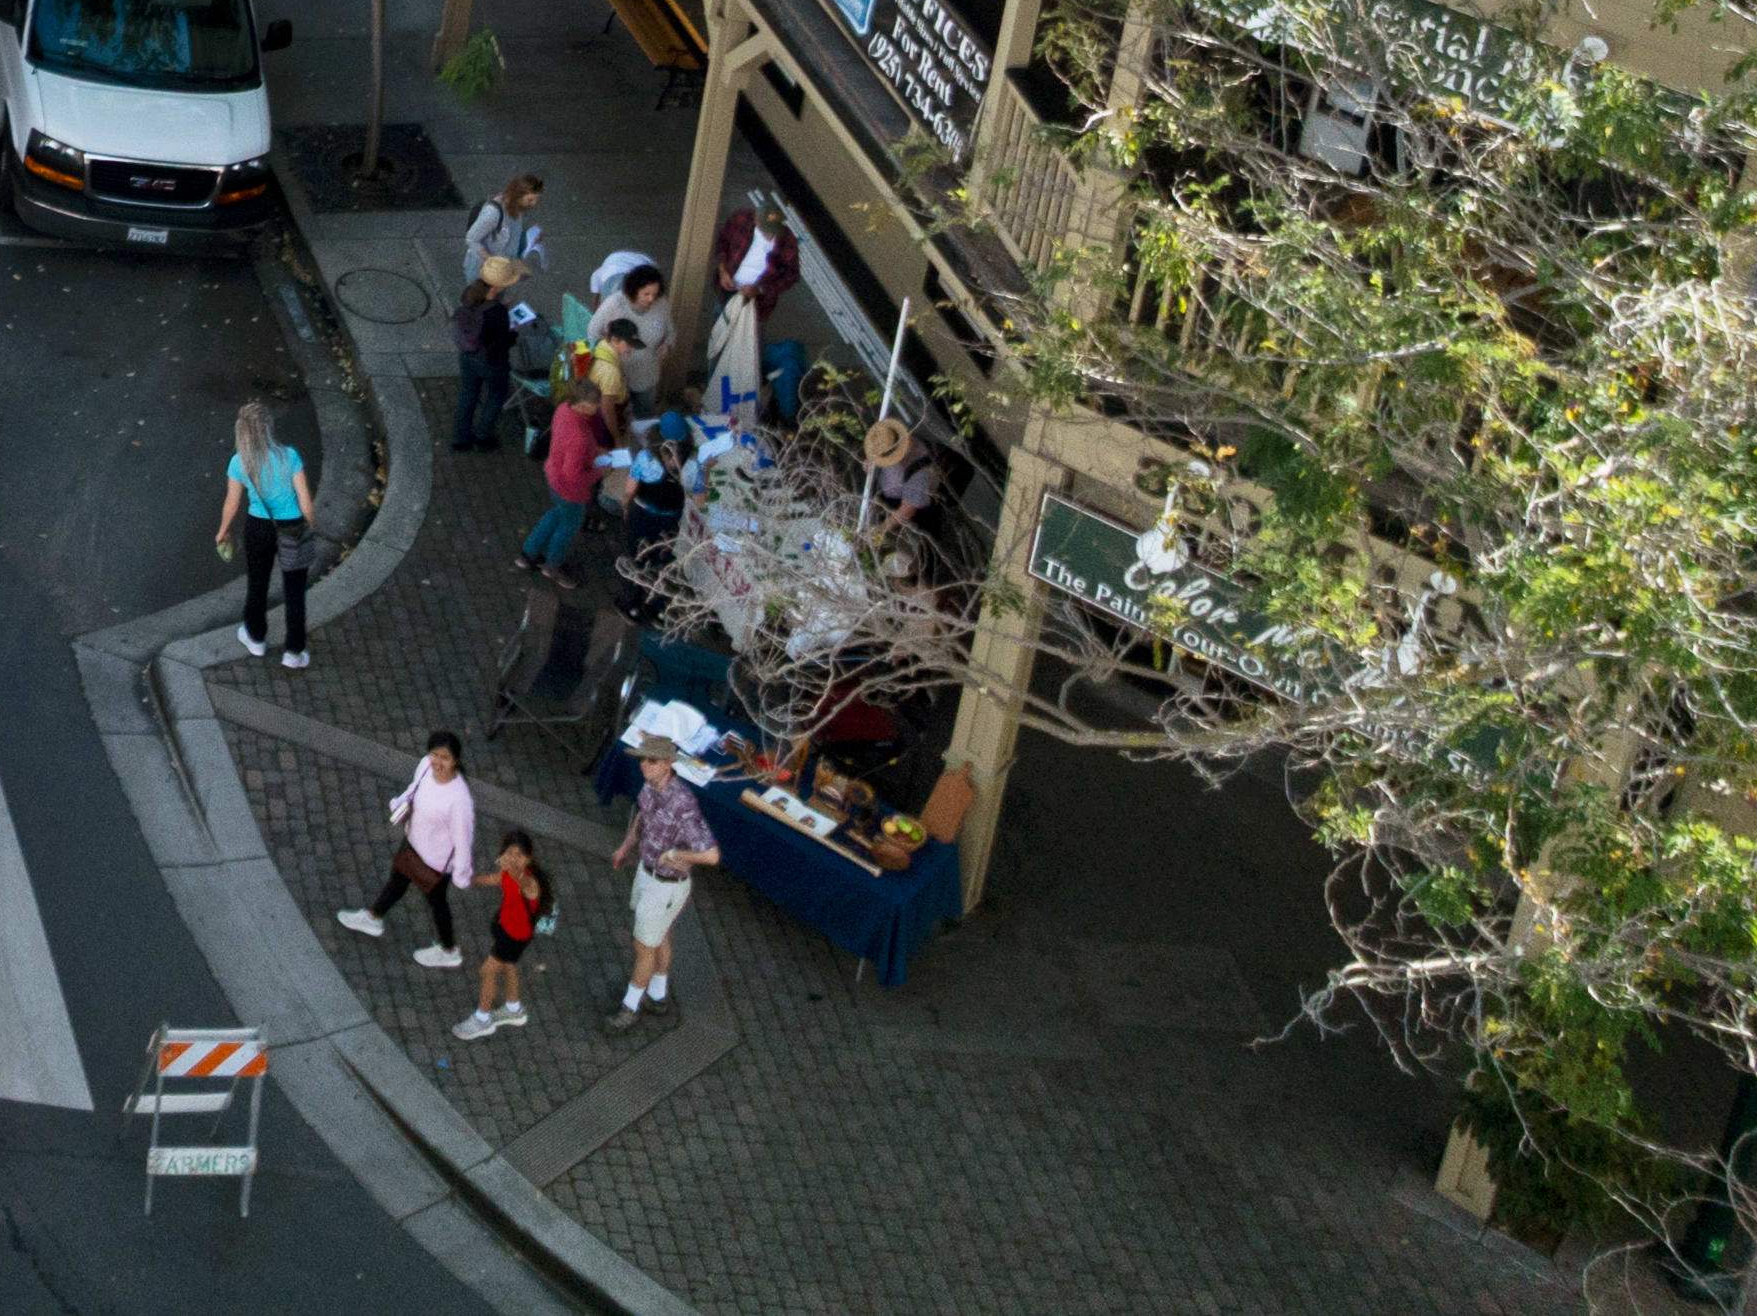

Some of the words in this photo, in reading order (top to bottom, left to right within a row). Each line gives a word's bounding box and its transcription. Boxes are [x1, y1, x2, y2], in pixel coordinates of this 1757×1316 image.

[867, 30, 903, 88] (925)
[891, 13, 921, 60] For
[917, 45, 955, 107] Rent
[1042, 558, 1087, 595] The
[1123, 556, 1240, 625] Color
